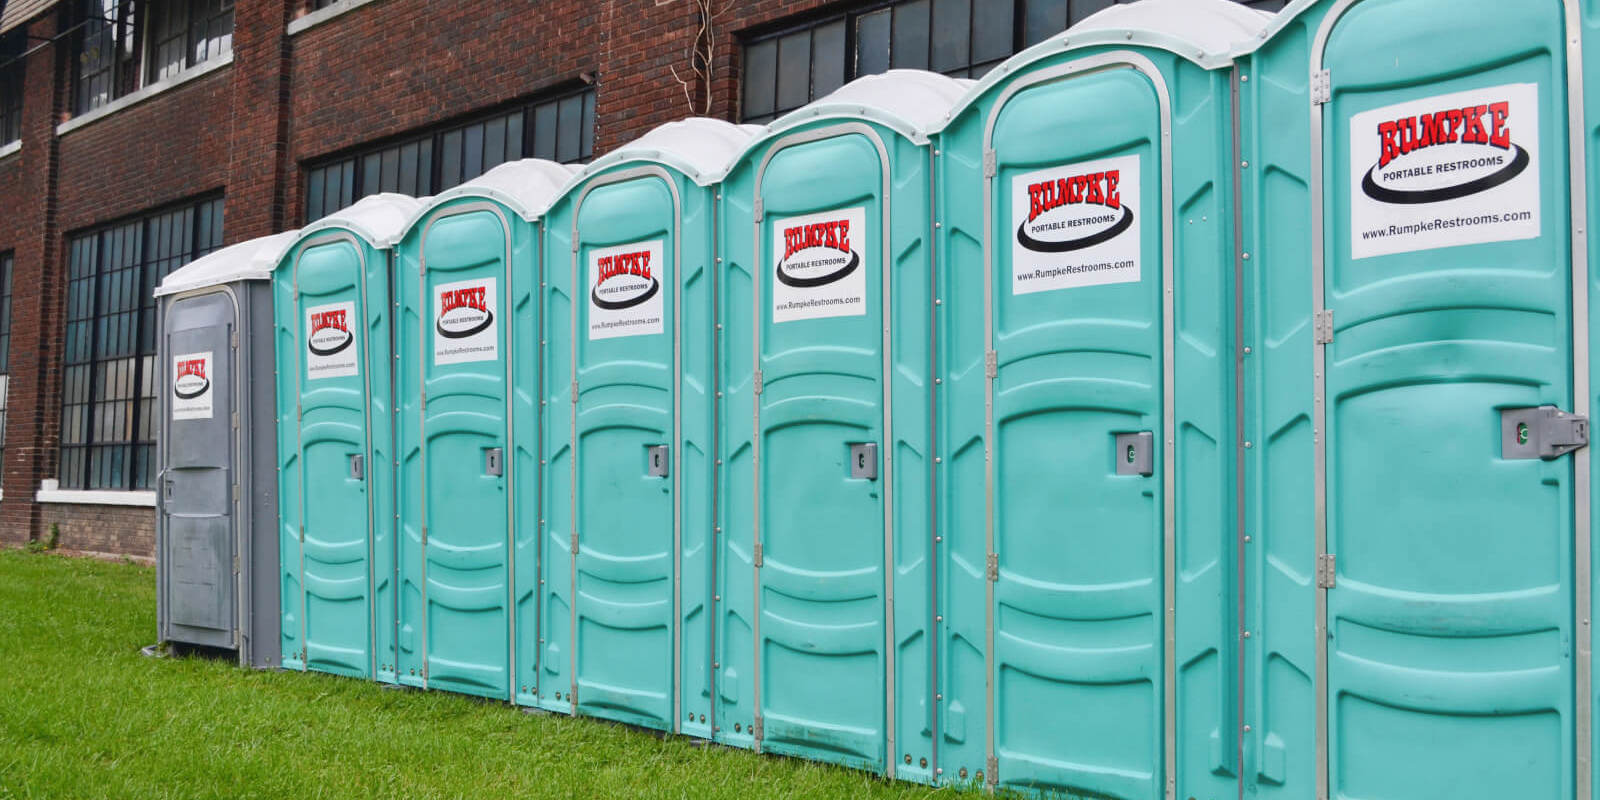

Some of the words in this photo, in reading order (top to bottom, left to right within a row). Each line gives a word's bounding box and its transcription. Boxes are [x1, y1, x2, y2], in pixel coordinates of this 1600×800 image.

[1377, 101, 1510, 170] RUMPKE
[1383, 165, 1433, 182] PORTABLE
[1436, 155, 1504, 174] RESTROOMS
[1028, 169, 1120, 224] RUMPKE
[1031, 221, 1066, 233] PORTABLE
[1067, 214, 1115, 227] RESTROOMS
[1362, 210, 1531, 240] www.RumpkeRestrooms.com
[783, 219, 850, 262] RUMPKE
[597, 250, 651, 287] RUMPKE
[786, 261, 810, 271] PORTABLE
[811, 257, 846, 268] RESTROOMS
[1017, 259, 1134, 281] www.RumpkeRestrooms.com
[441, 286, 487, 318] RUMPKE
[776, 296, 861, 311] www.RumpkeRestrooms.com
